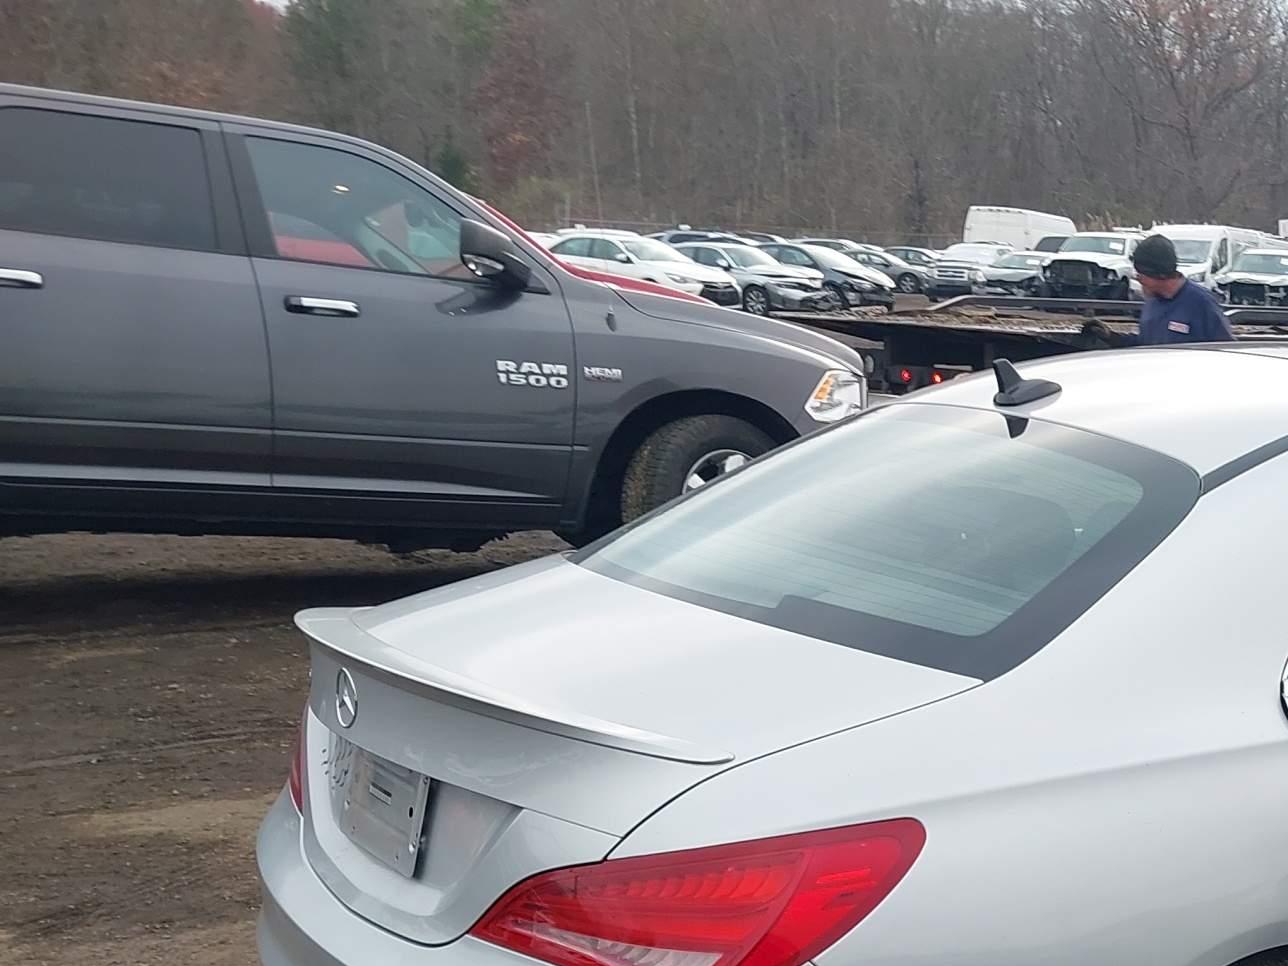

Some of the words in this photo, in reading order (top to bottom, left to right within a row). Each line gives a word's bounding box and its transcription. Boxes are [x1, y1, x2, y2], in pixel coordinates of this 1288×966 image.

[496, 360, 568, 375] RAM
[583, 366, 622, 379] HEMI
[497, 372, 568, 388] 1500
